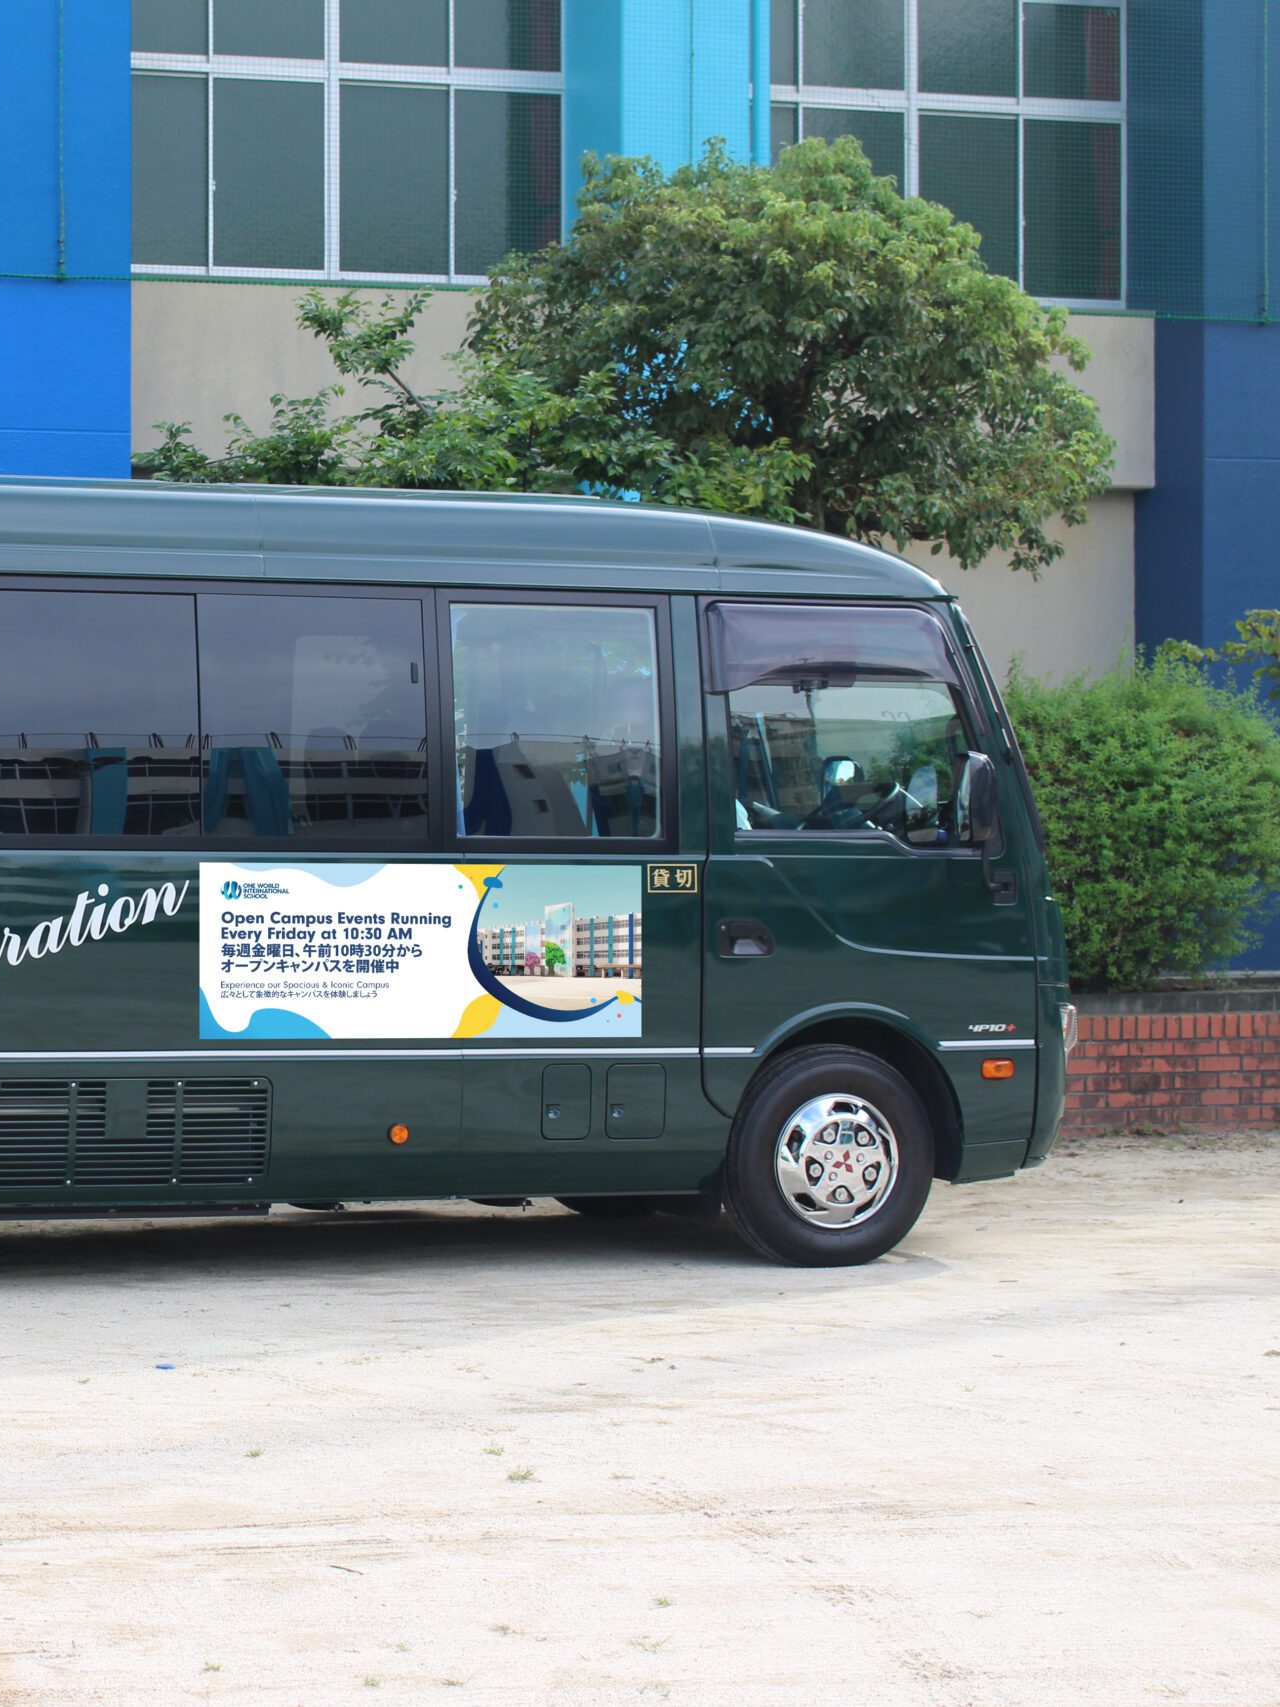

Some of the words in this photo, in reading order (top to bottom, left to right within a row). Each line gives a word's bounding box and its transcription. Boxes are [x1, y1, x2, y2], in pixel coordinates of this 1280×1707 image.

[652, 868, 693, 888] 貸切
[221, 911, 265, 927] Open
[270, 911, 333, 927] Campus
[337, 912, 385, 925] Events
[390, 912, 452, 928] Running
[221, 927, 262, 942] Every
[267, 927, 316, 942] Friday
[321, 928, 337, 940] at
[343, 927, 382, 940] 10:30
[387, 927, 413, 940] AM
[221, 959, 400, 974] オープンキャンパスを開催中
[221, 981, 265, 990] Experience
[283, 981, 320, 990] Spacious
[331, 981, 354, 989] Iconic
[356, 981, 390, 990] Campus
